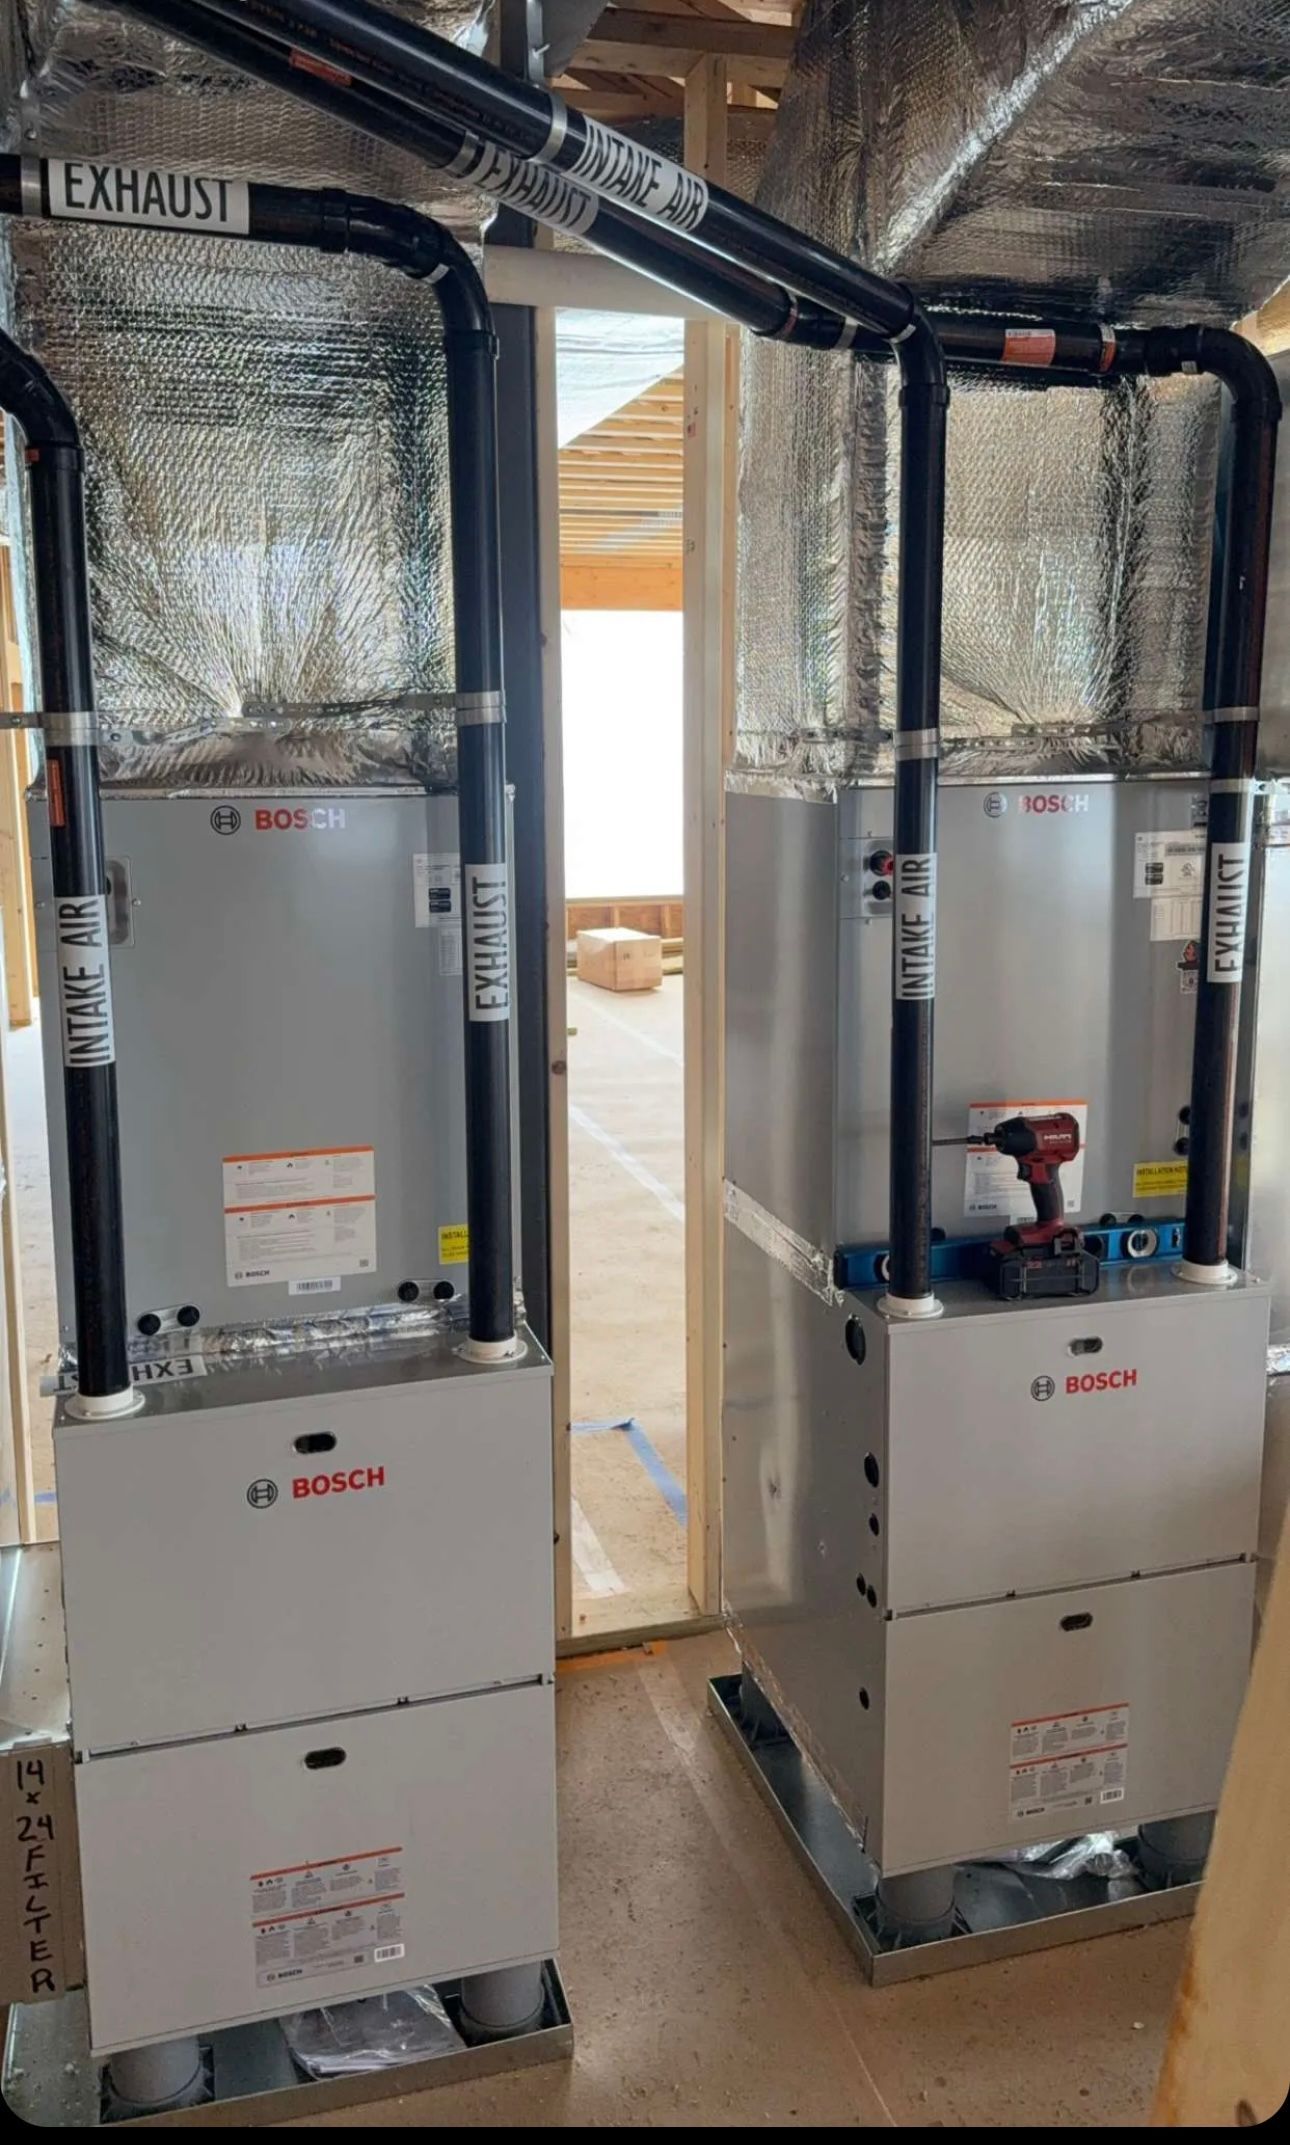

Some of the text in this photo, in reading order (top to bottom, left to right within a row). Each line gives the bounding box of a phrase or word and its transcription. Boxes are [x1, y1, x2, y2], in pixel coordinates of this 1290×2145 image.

[65, 162, 233, 222] EXHAUST
[473, 149, 591, 229] EXHAUST
[572, 124, 705, 230] INTAKE AIR
[255, 808, 346, 831] BOSCH
[1019, 794, 1089, 814] BOSCH
[471, 876, 509, 1010] EXHAUST
[901, 858, 934, 997] INTAKE AIR
[1213, 853, 1245, 973] EXHAUST
[58, 898, 110, 1064] INTAKE AIR
[1066, 1369, 1137, 1394] BOSCH
[292, 1466, 385, 1499] BOSCH
[17, 1760, 44, 1790] 14
[17, 1814, 54, 1842] 24
